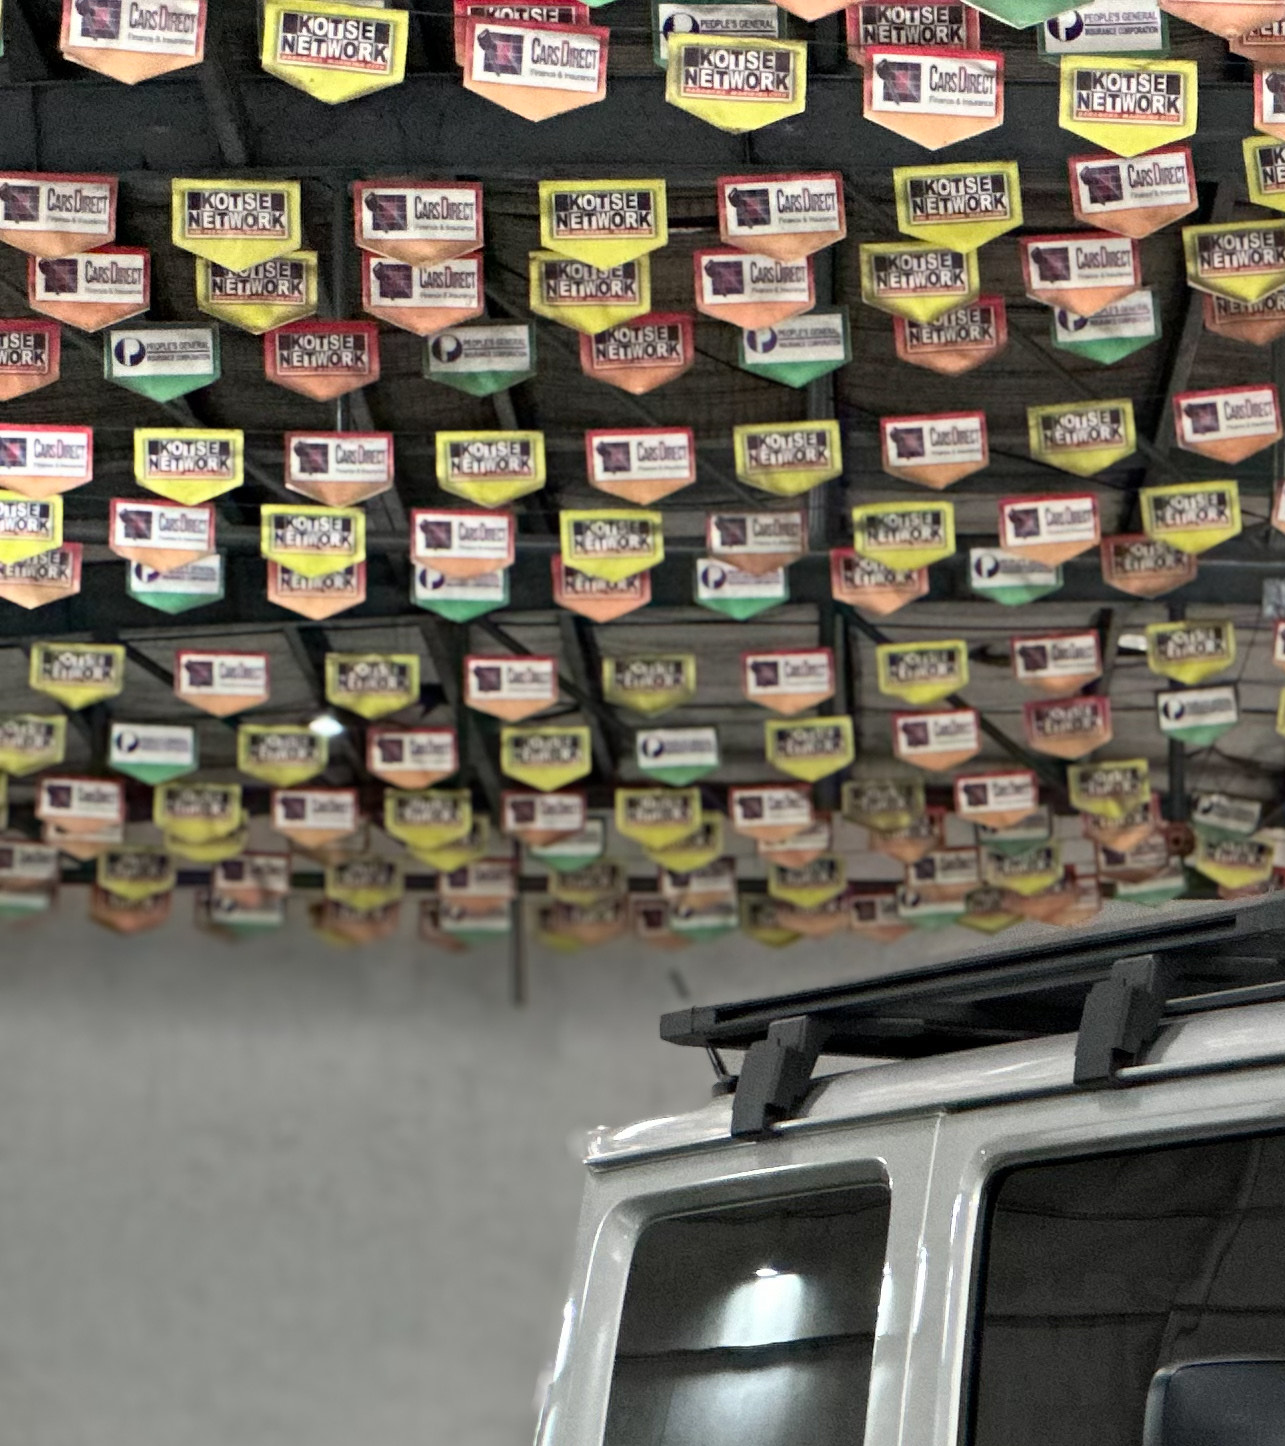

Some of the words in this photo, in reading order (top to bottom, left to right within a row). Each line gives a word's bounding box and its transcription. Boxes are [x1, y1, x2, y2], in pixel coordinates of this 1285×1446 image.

[878, 7, 948, 26] KOTSE
[298, 14, 375, 40] KOTSE
[862, 24, 965, 46] NETWORK
[282, 36, 388, 63] NETWORK
[700, 50, 775, 69] KOTSE
[684, 69, 789, 91] NETWORK
[1093, 73, 1166, 94] KOTSE
[1078, 92, 1179, 114] NETWORK
[924, 175, 990, 195] KOTSE
[203, 192, 270, 210] KOTSE
[568, 192, 637, 210] KOTSE
[912, 193, 1006, 214] NETWORK
[188, 211, 285, 230] NETWORK
[556, 212, 652, 229] NETWORK
[1211, 233, 1274, 250] KOTSE
[889, 254, 951, 271] KOTSE
[212, 279, 301, 297] NETWORK
[875, 269, 963, 289] NETWORK
[547, 281, 635, 298] NETWORK
[291, 335, 352, 352] KOTSE
[607, 326, 667, 344] KOTSE
[280, 352, 366, 367] NETWORK
